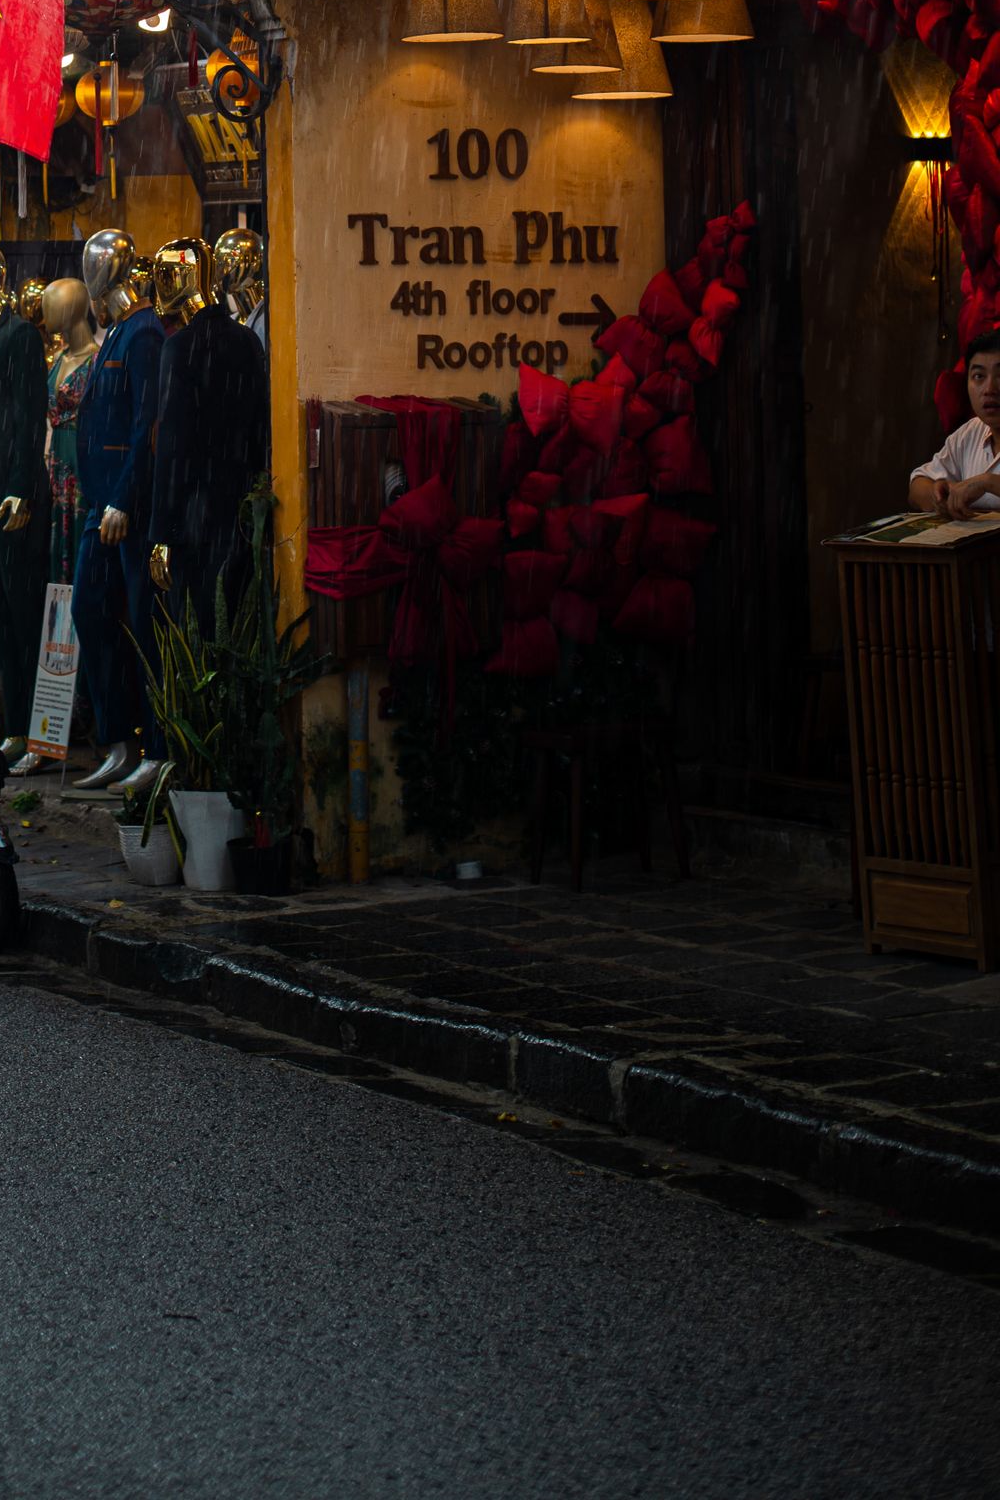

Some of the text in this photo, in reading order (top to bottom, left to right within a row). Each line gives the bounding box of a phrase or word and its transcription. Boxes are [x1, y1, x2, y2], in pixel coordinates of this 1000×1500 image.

[427, 128, 529, 181] 100
[347, 210, 619, 266] Tran Phu
[390, 279, 556, 316] 4th floor
[416, 333, 569, 375] Rooftop
